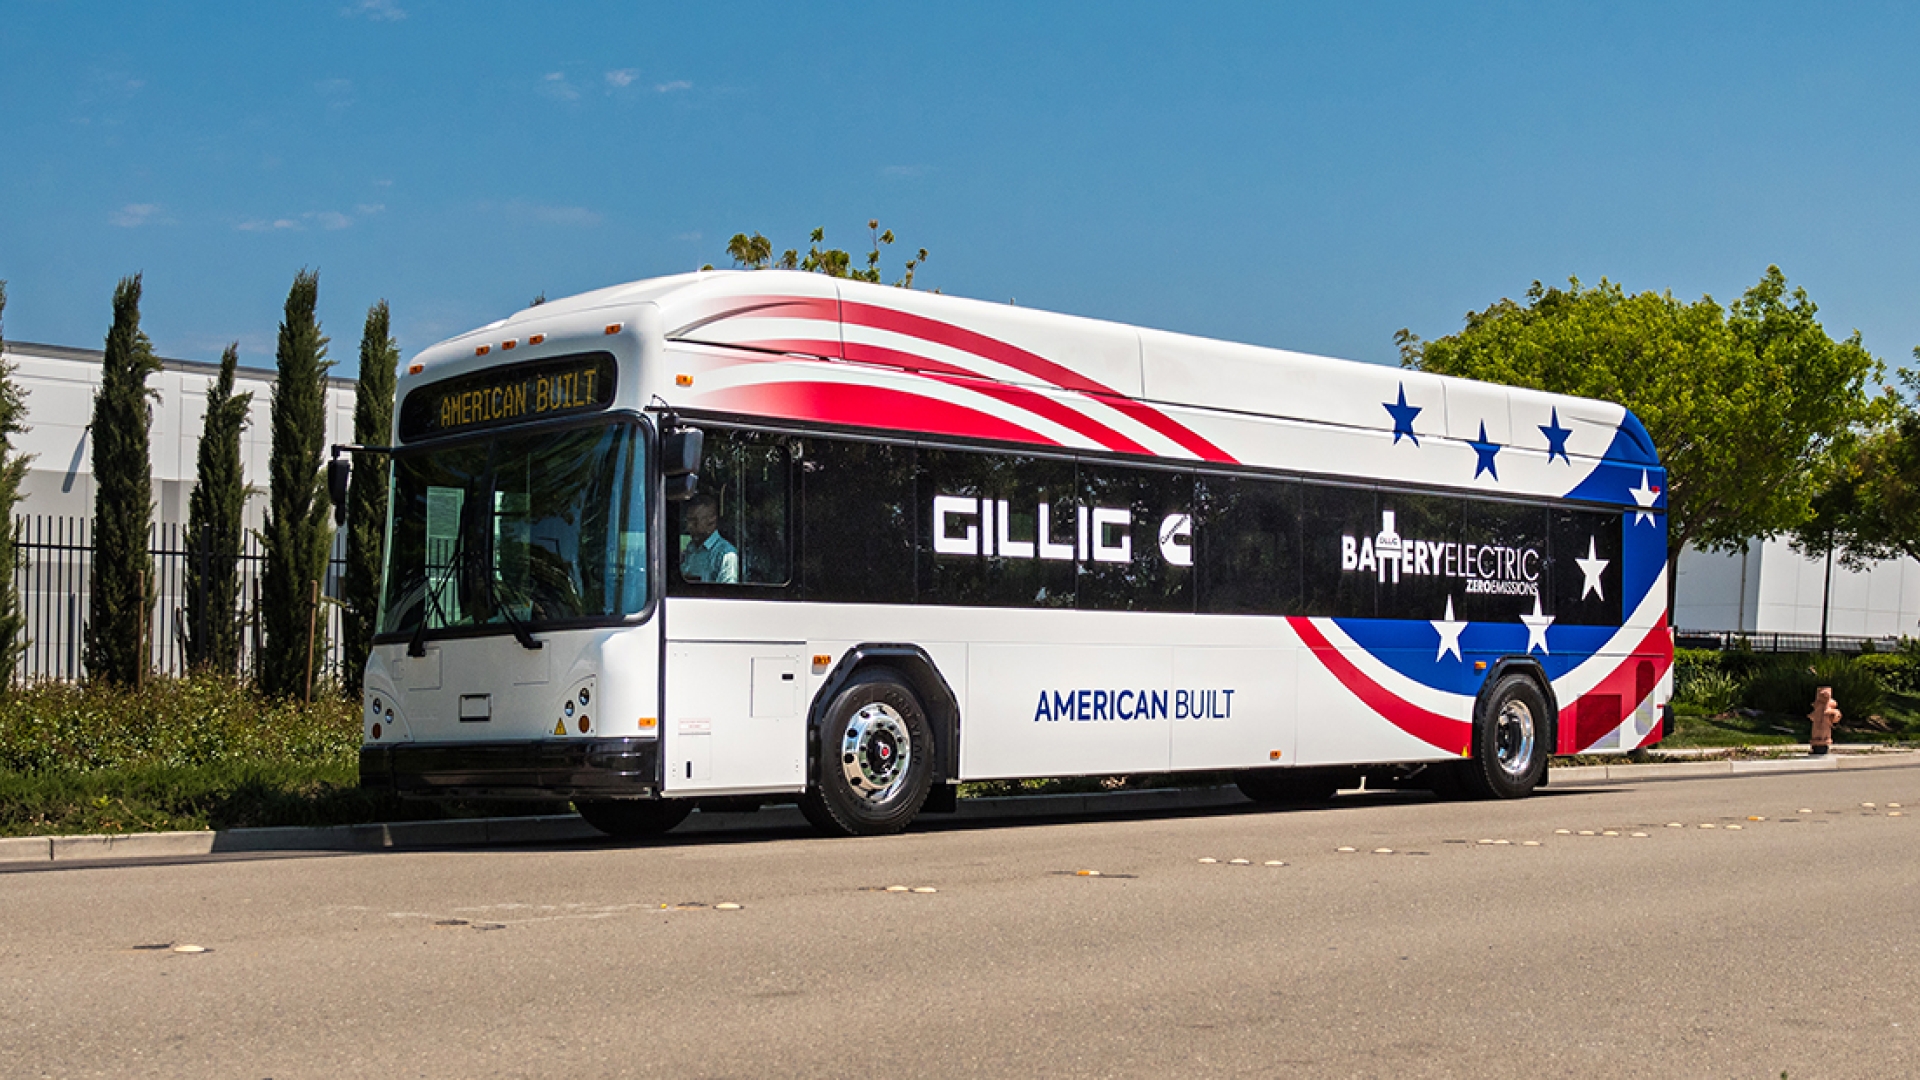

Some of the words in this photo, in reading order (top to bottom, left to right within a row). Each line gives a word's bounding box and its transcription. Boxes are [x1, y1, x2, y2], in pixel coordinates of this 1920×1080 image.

[441, 381, 527, 428] AMERICAN
[536, 368, 597, 413] BUILT
[933, 495, 1132, 563] GILLIG
[1034, 689, 1168, 722] AMERICAN
[1175, 689, 1235, 719] BUILT
